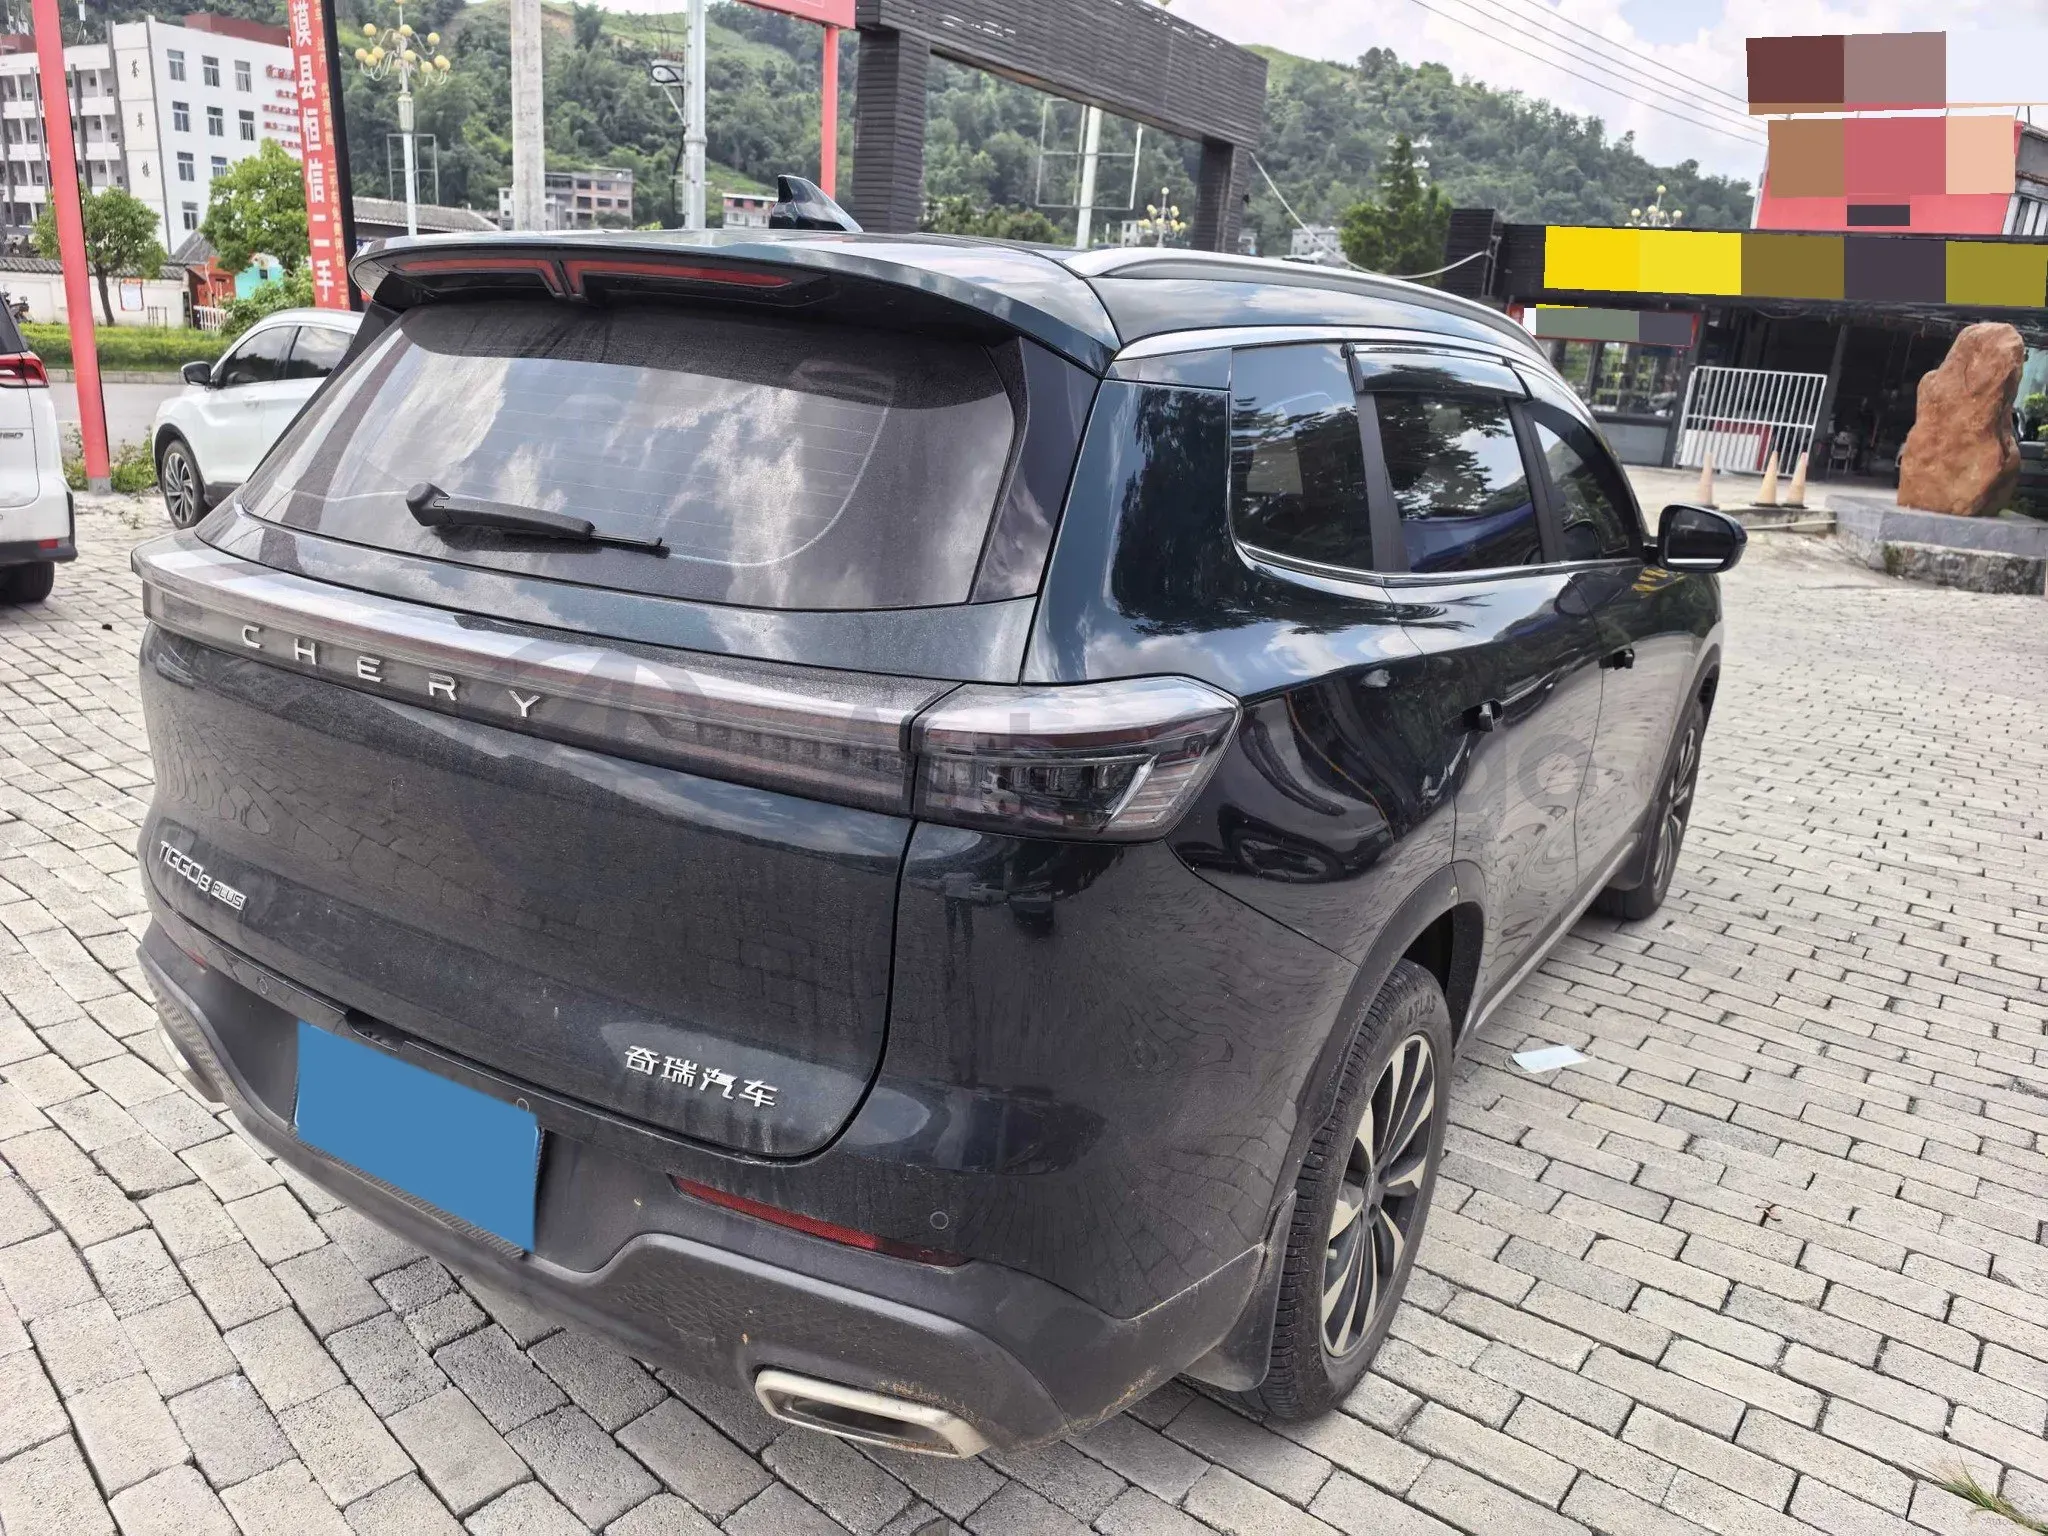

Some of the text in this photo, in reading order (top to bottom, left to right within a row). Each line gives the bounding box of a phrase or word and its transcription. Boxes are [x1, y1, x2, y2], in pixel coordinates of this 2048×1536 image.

[241, 624, 541, 718] CHERY
[212, 882, 246, 909] PLUS
[624, 1045, 779, 1107] 奇瑞汽车
